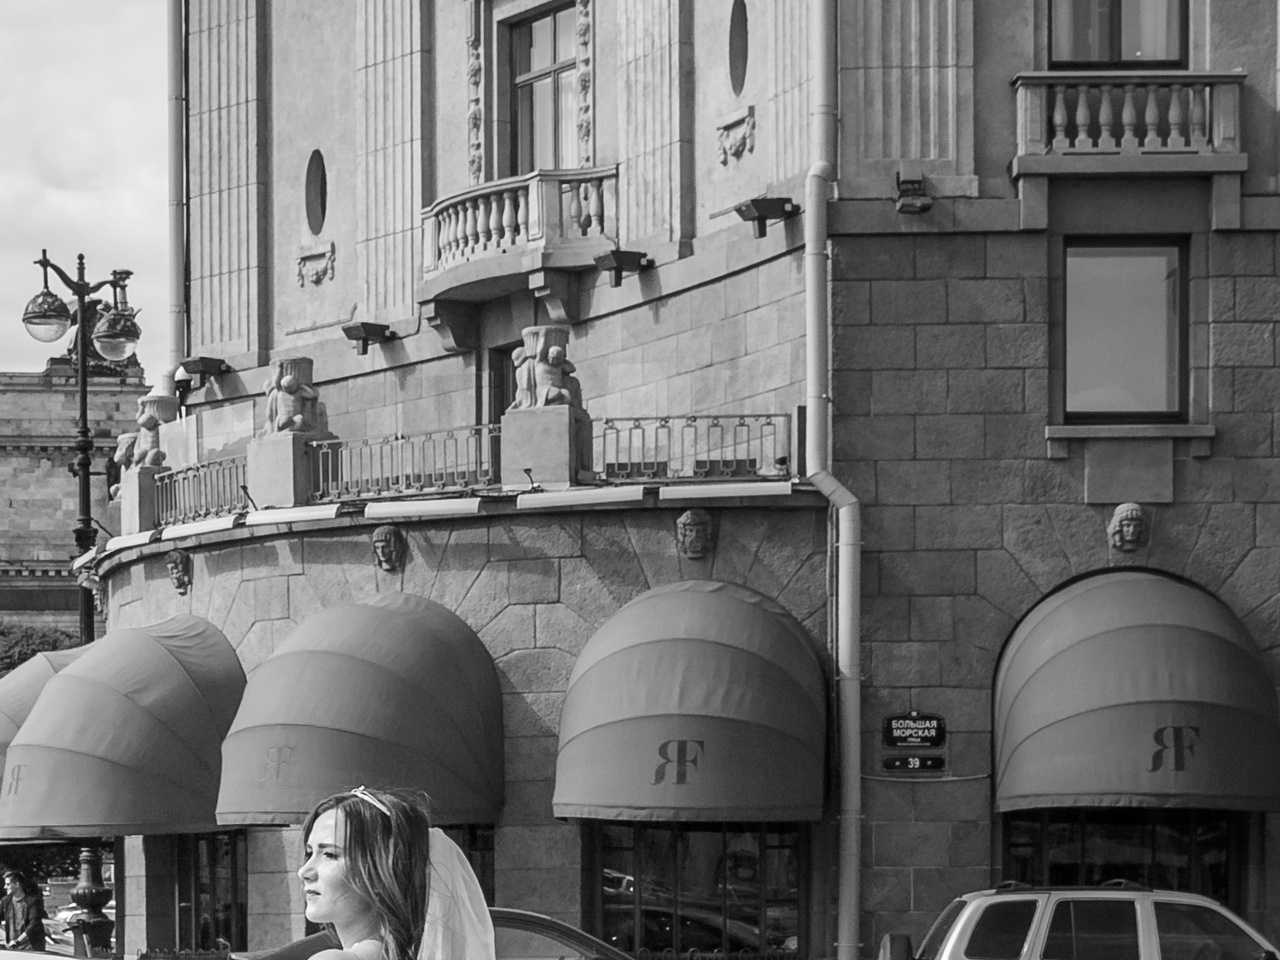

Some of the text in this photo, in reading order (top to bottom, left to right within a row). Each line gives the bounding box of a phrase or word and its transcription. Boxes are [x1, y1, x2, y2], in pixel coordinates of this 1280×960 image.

[891, 719, 937, 729] БОЛЬШАЯ
[892, 729, 936, 738] МОРСКАЯ
[907, 757, 920, 769] 39
